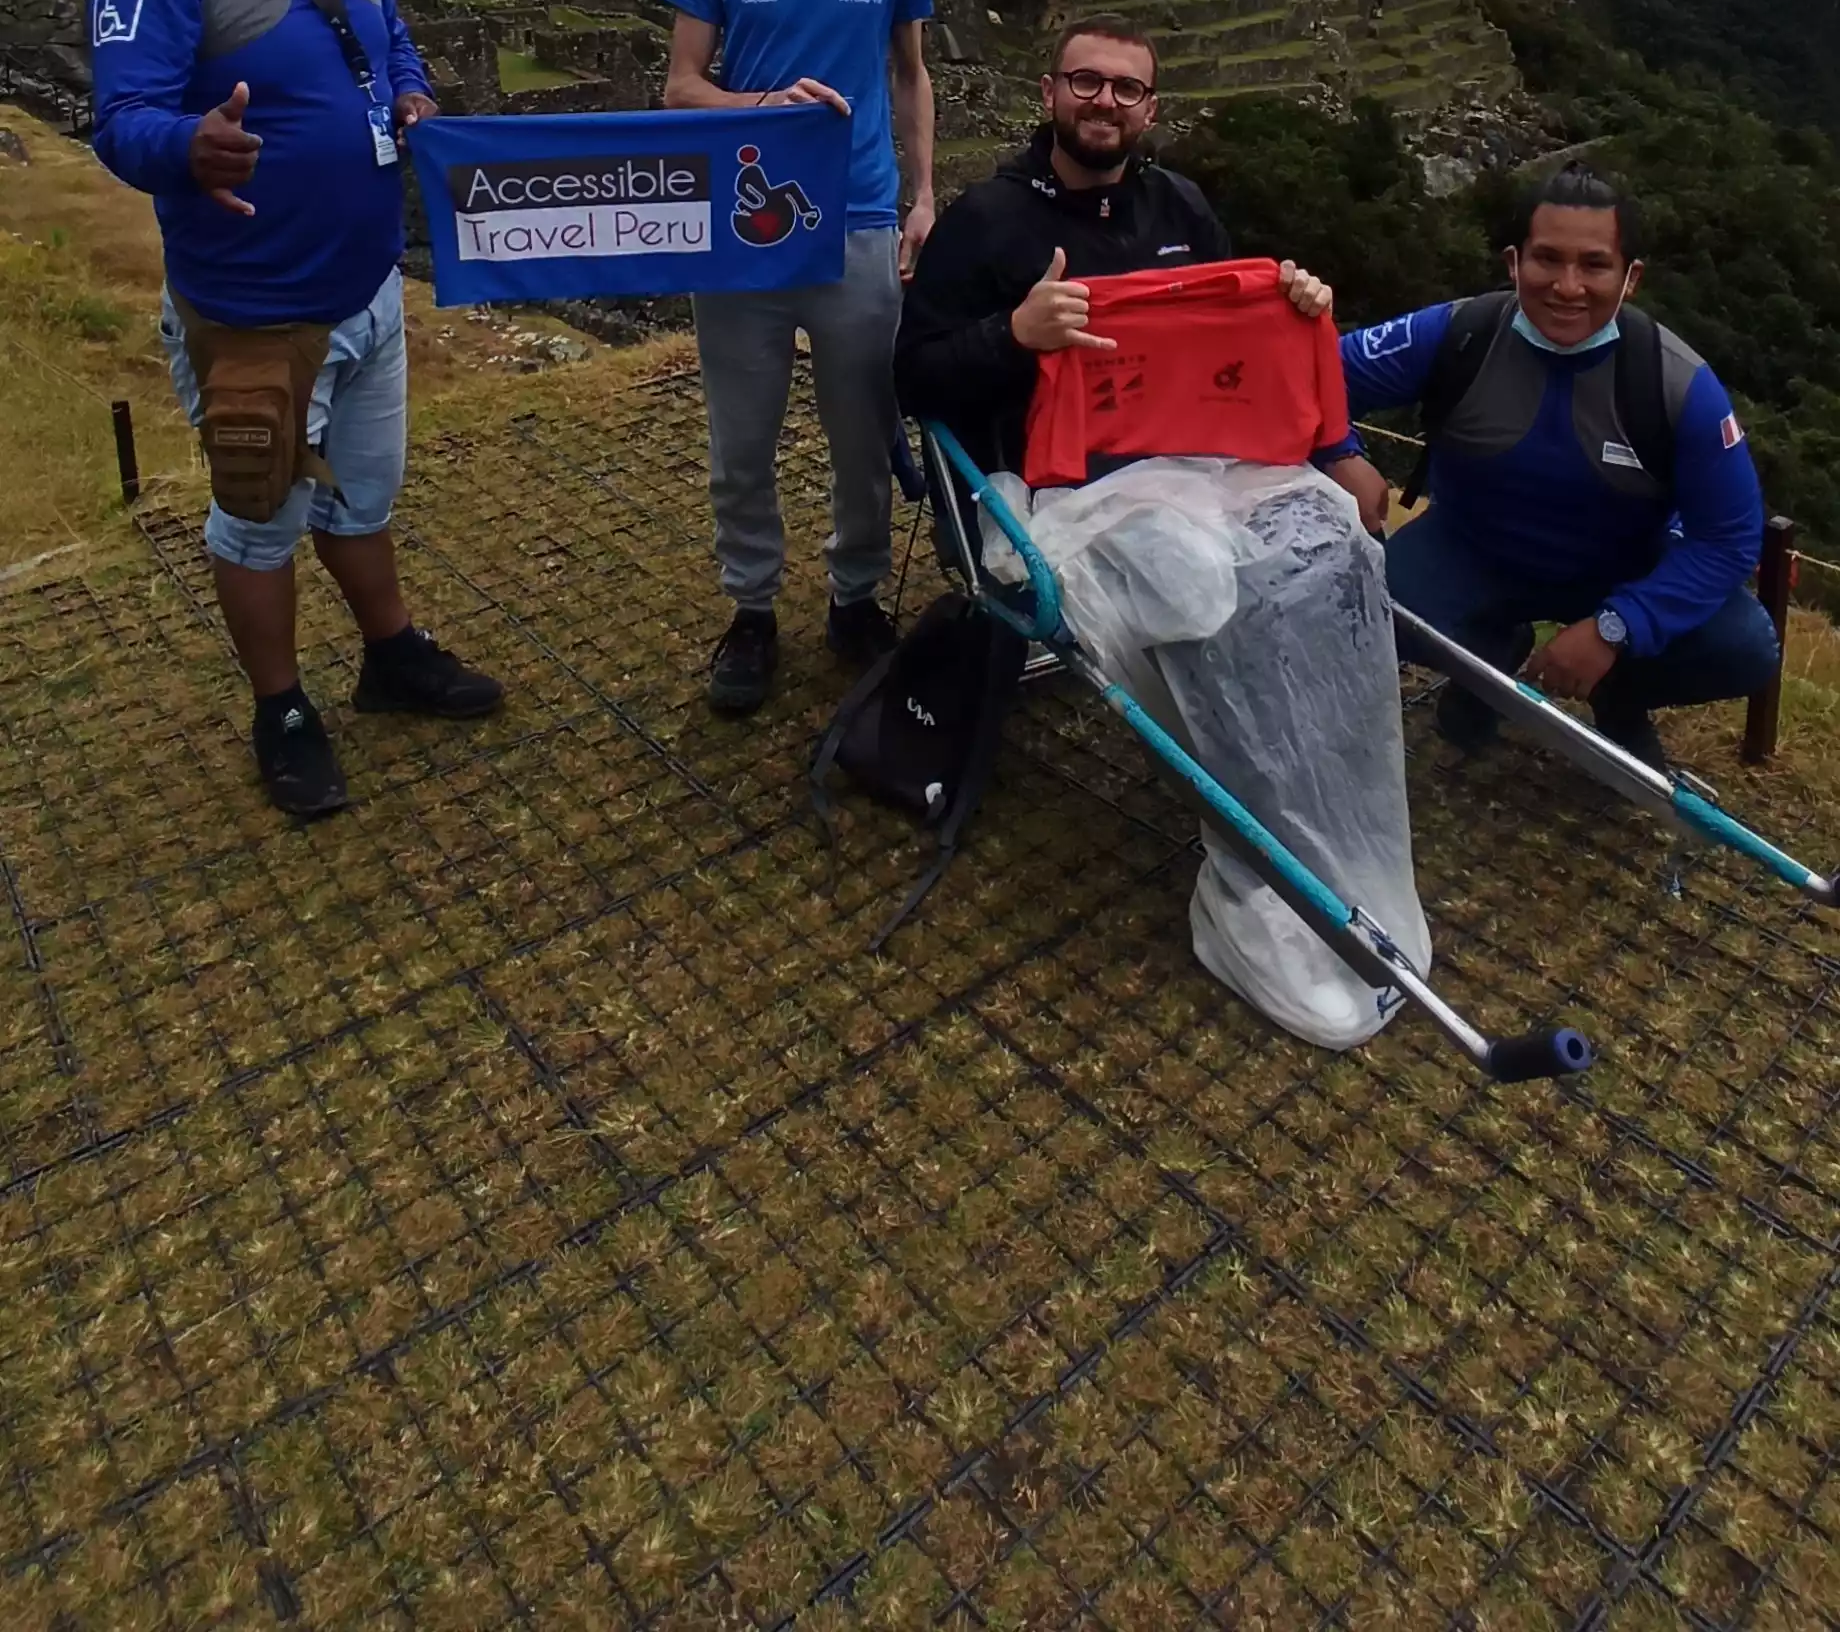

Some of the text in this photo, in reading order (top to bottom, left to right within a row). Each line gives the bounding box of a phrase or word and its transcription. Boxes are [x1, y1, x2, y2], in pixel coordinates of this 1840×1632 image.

[466, 159, 697, 206] Accessible
[464, 211, 705, 254] Travel Peru
